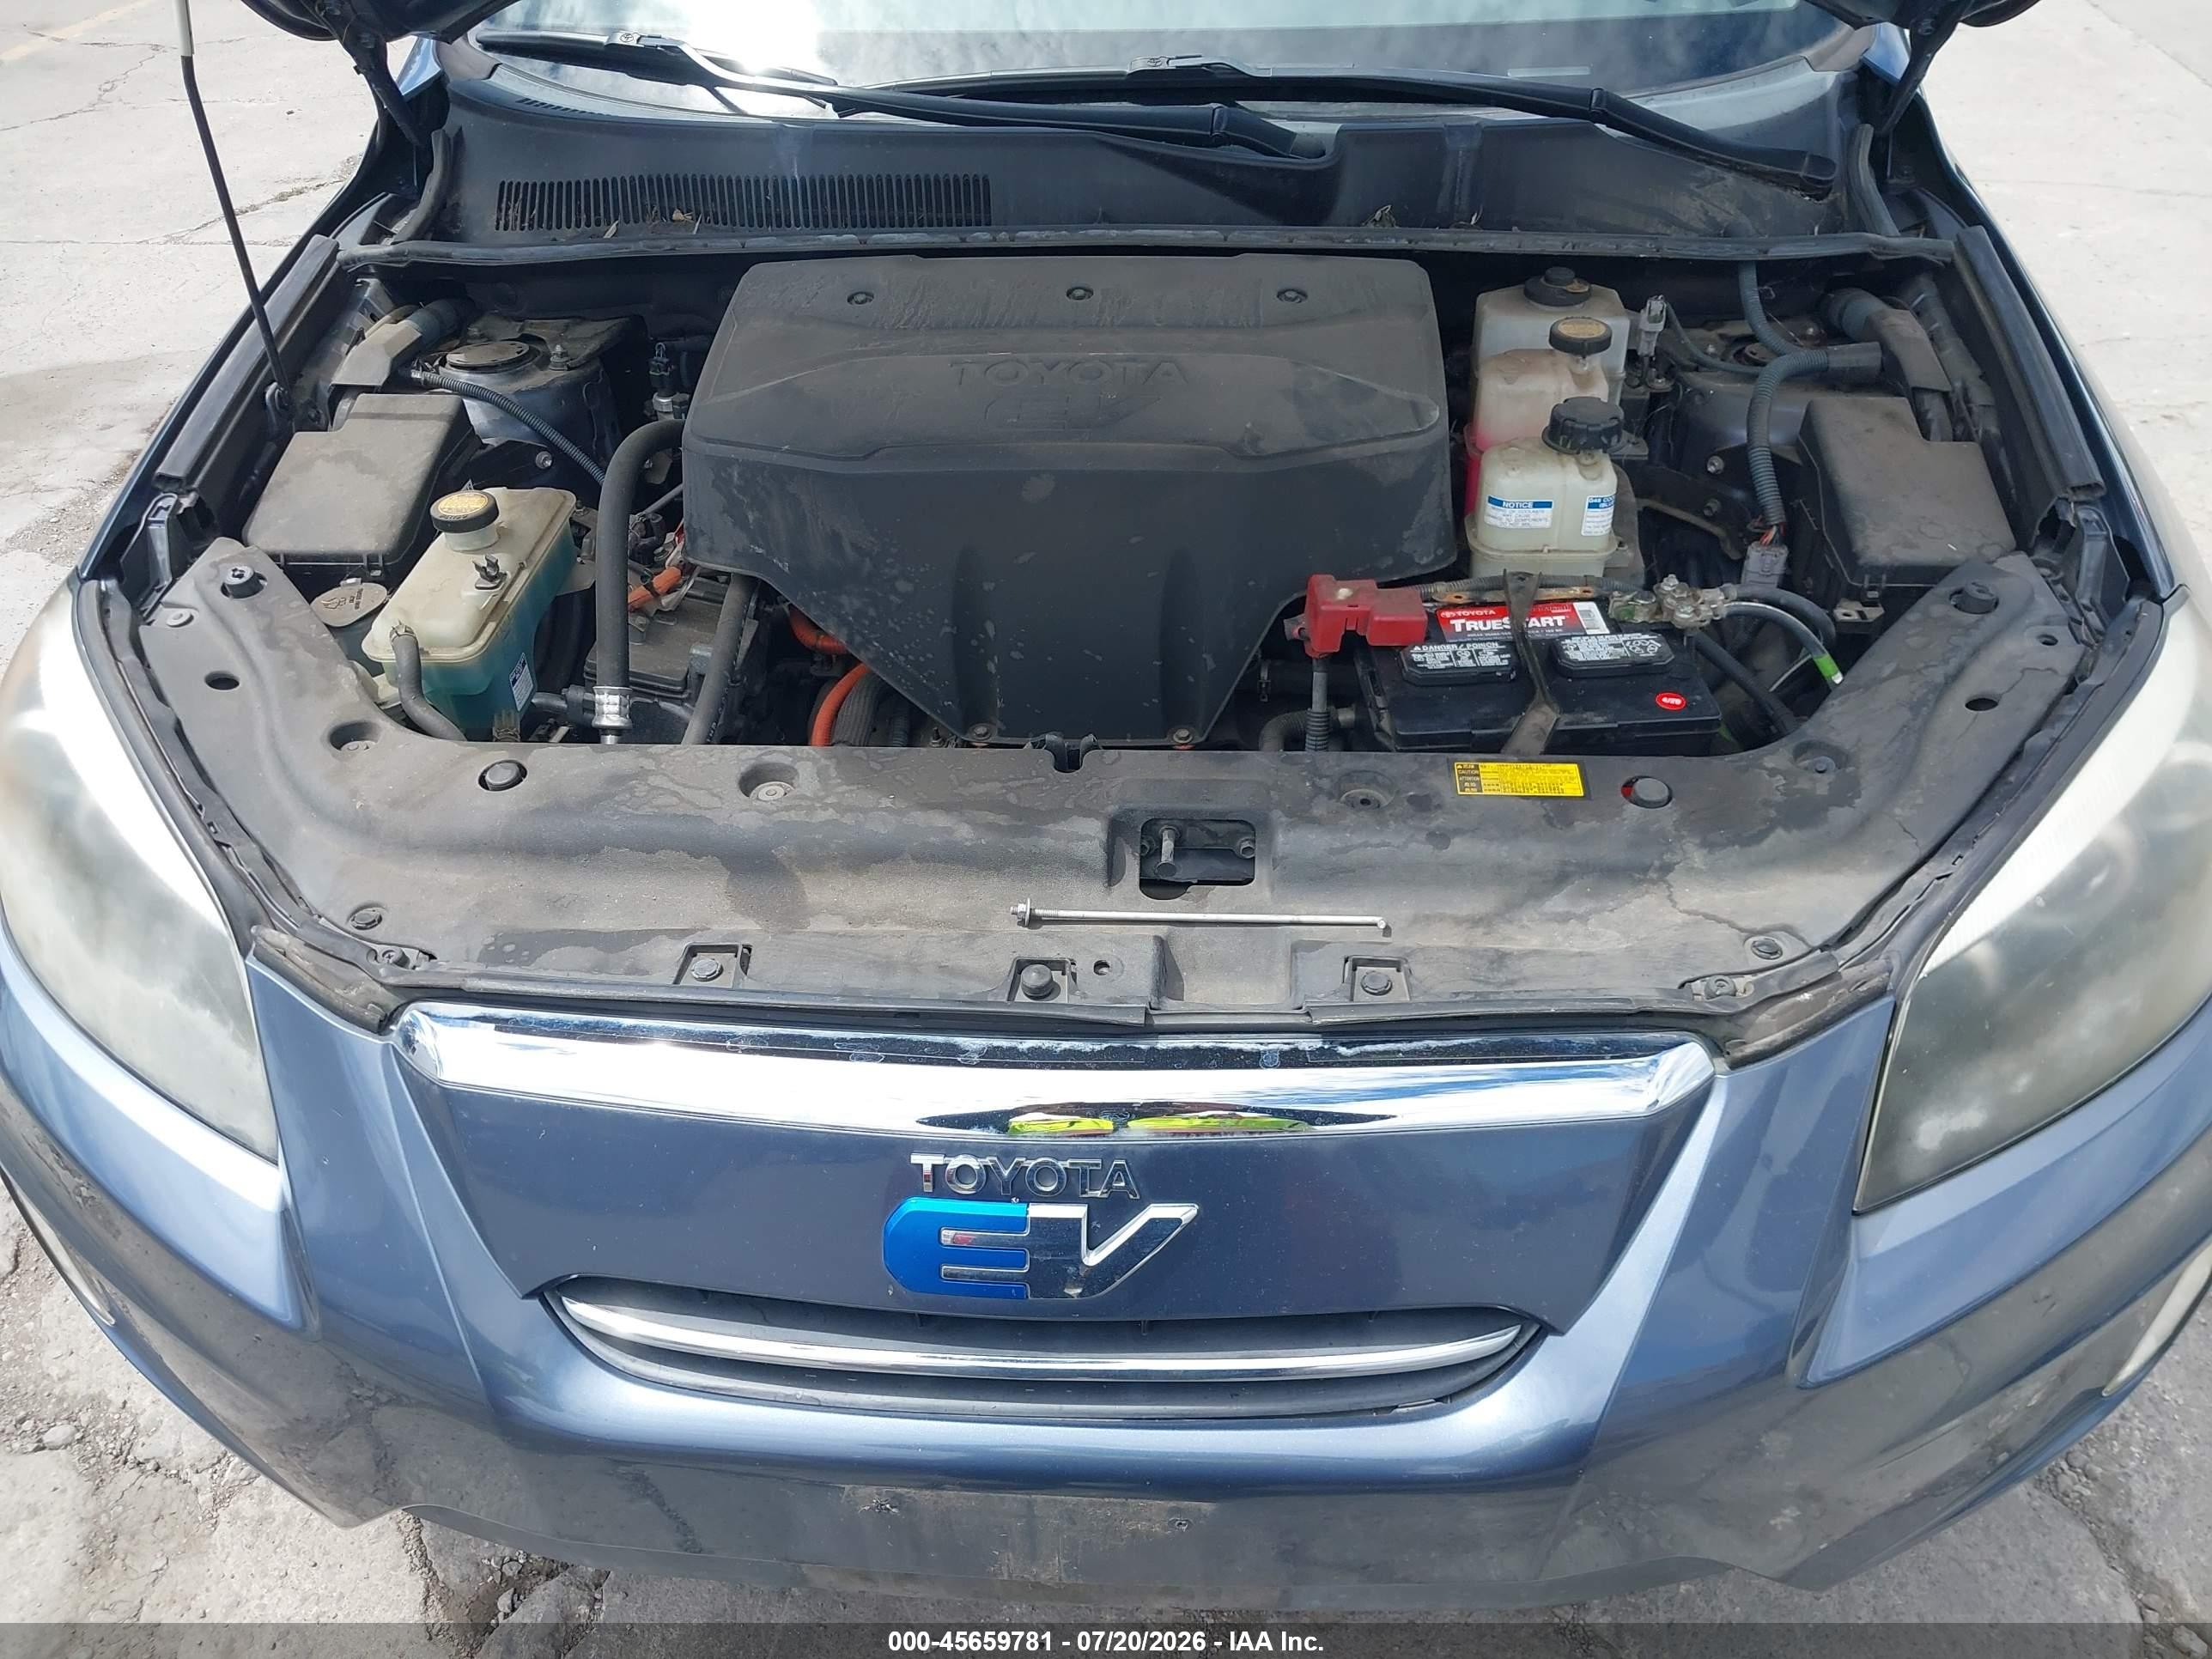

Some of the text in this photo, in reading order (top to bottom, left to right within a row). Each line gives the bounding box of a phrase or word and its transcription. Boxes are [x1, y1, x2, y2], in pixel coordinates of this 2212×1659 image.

[949, 358, 1189, 386] TOYOTA
[1503, 501, 1534, 509] NOTICE
[1449, 616, 1566, 633] TRUESART
[909, 1152, 1140, 1200] TOYOTA
[883, 1196, 1200, 1300] EV
